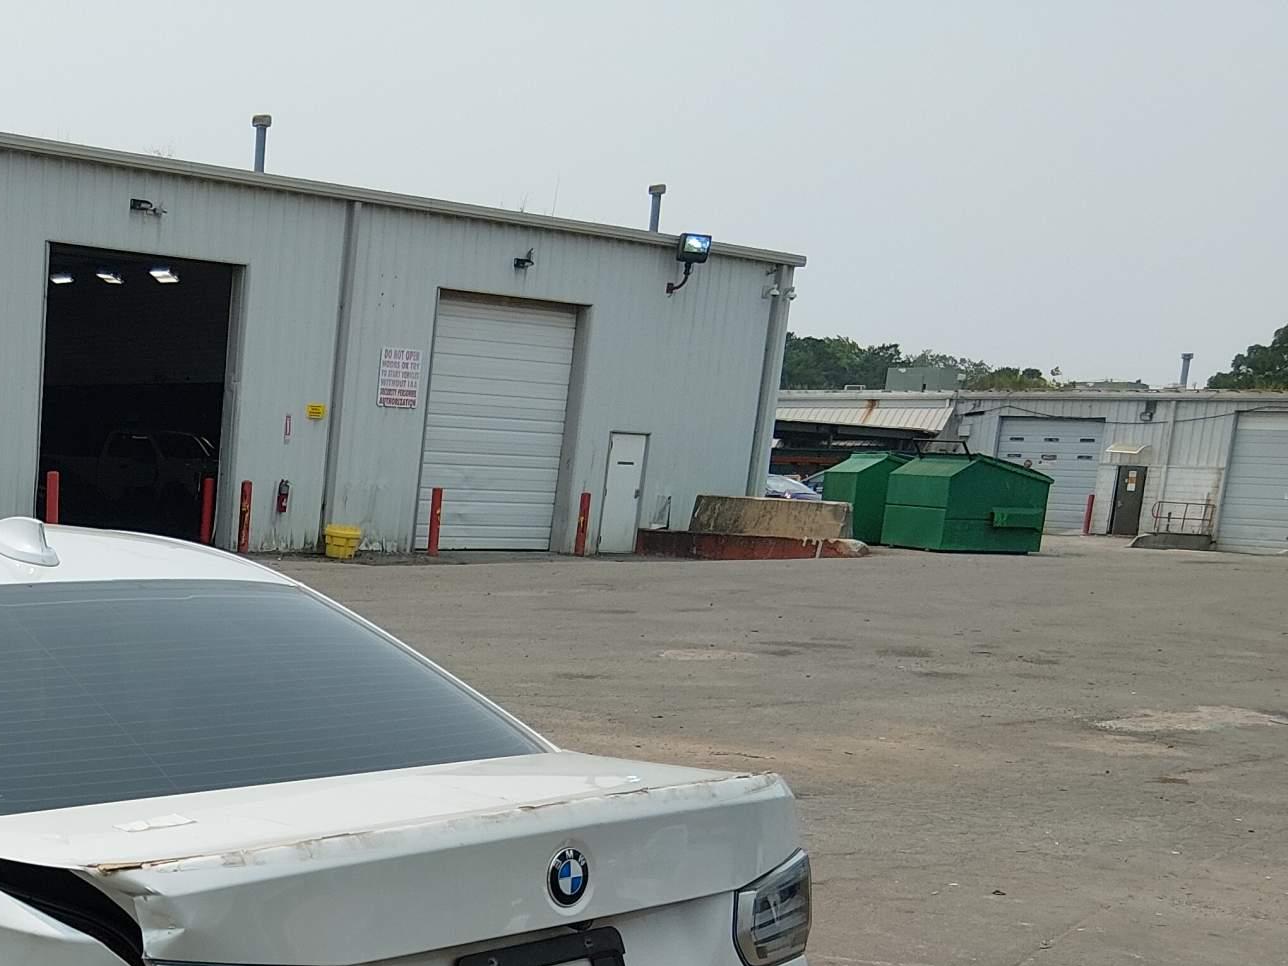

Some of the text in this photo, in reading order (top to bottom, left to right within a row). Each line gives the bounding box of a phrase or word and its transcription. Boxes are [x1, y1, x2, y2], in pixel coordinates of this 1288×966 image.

[384, 349, 420, 361] DO NOT OPEN
[553, 849, 587, 870] BMW
